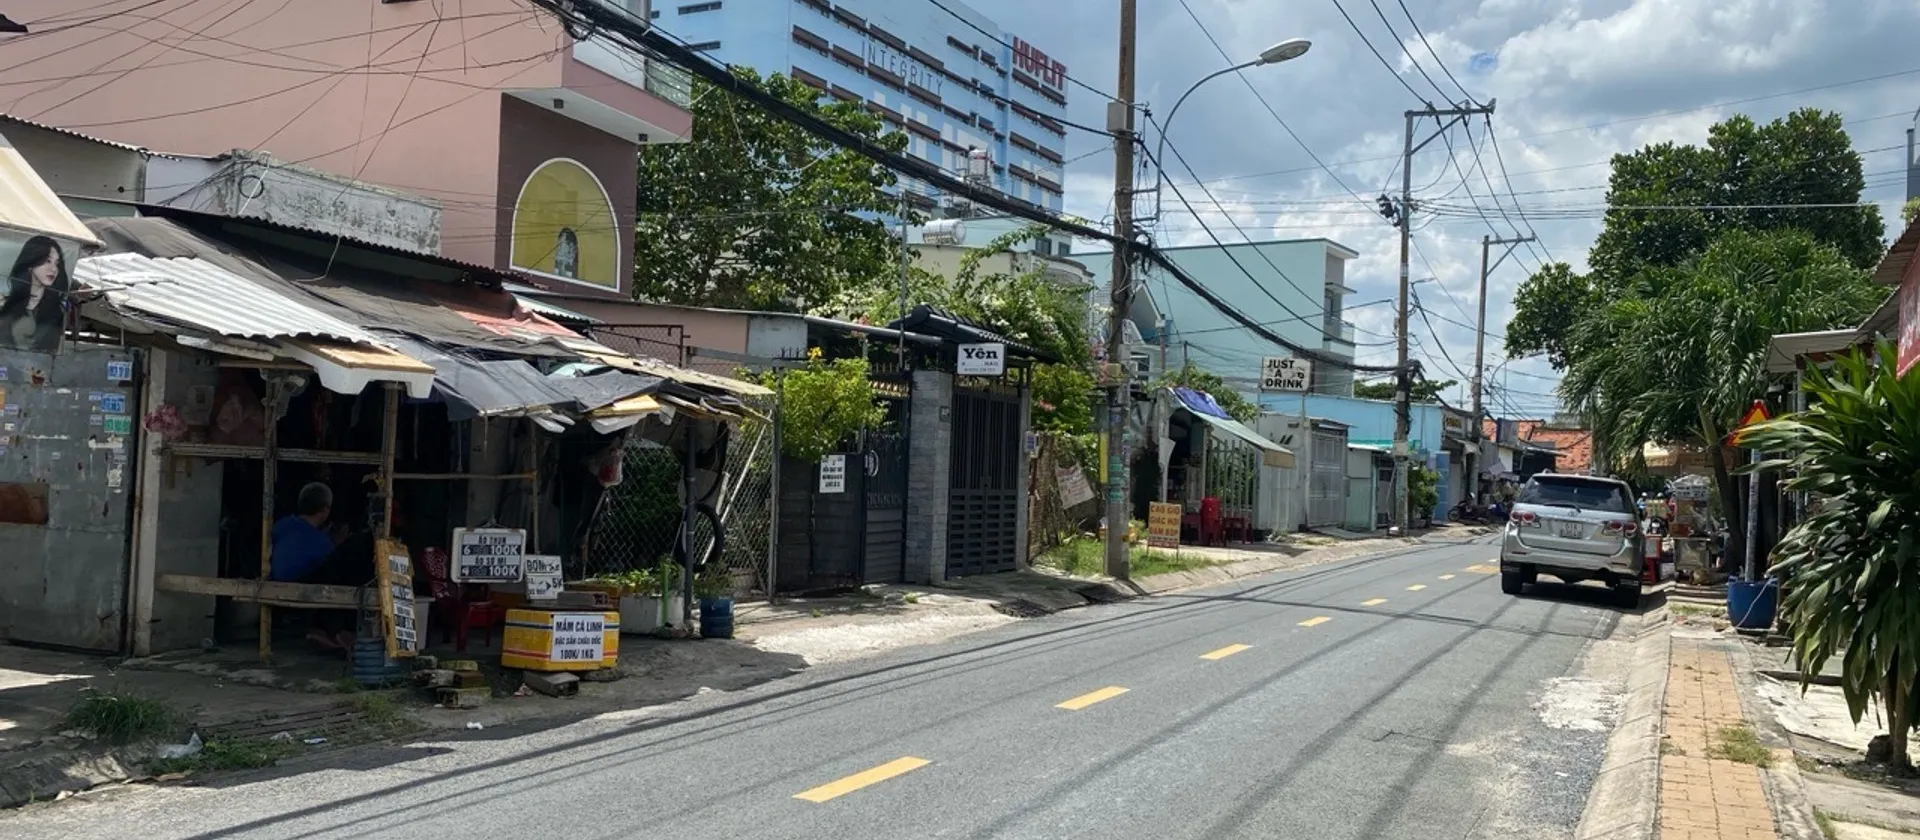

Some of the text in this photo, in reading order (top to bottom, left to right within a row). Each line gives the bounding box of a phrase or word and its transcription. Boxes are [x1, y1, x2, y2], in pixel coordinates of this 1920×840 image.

[861, 41, 943, 96] INTEGRITY
[1013, 36, 1066, 91] HUFLIT
[963, 347, 998, 360] Yên
[1267, 359, 1295, 369] JUST
[1274, 369, 1282, 377] A
[1265, 378, 1303, 388] DRINK
[463, 545, 471, 555] 6
[491, 545, 519, 555] 100K
[462, 567, 470, 576] 4
[489, 566, 518, 576] 100K
